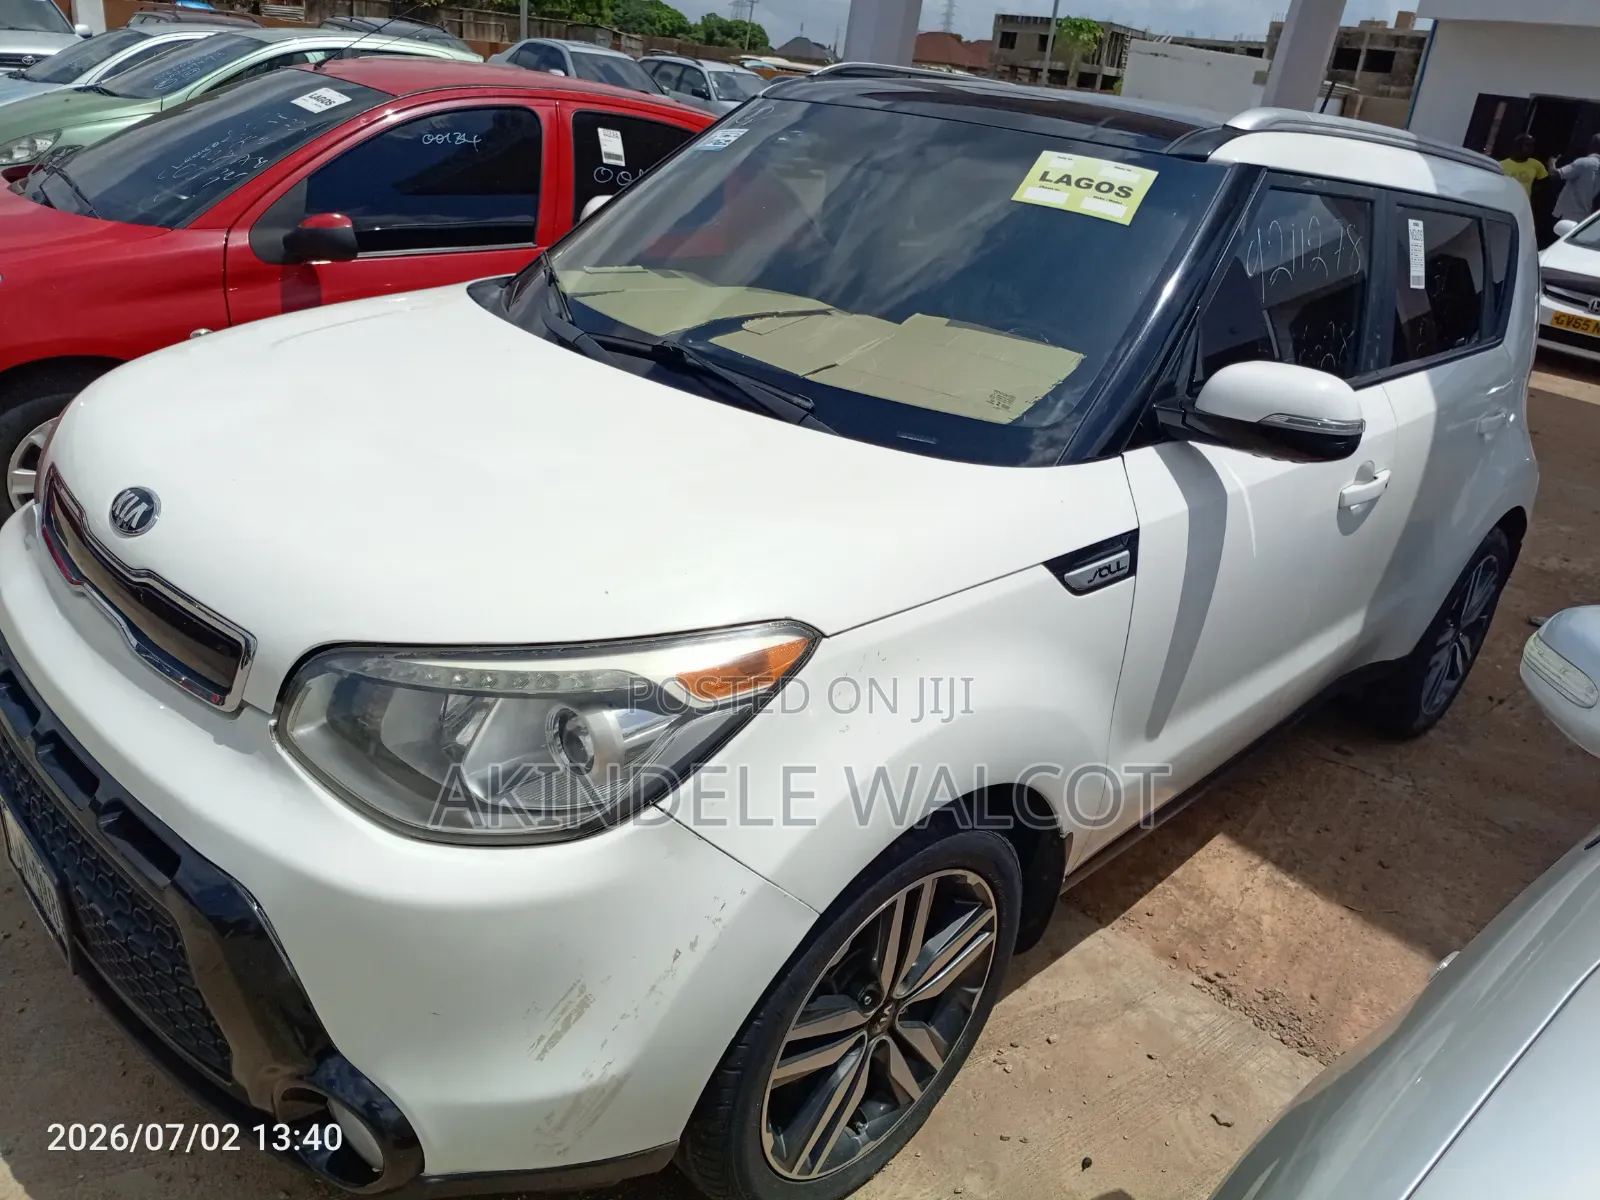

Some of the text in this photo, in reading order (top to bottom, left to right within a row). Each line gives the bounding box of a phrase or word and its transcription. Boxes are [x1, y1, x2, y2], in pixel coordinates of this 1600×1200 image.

[308, 92, 336, 105] LAGOS
[1038, 170, 1134, 199] LAGOS
[1555, 314, 1592, 331] GV65
[112, 489, 148, 529] KIA
[1087, 560, 1128, 584] SOUL
